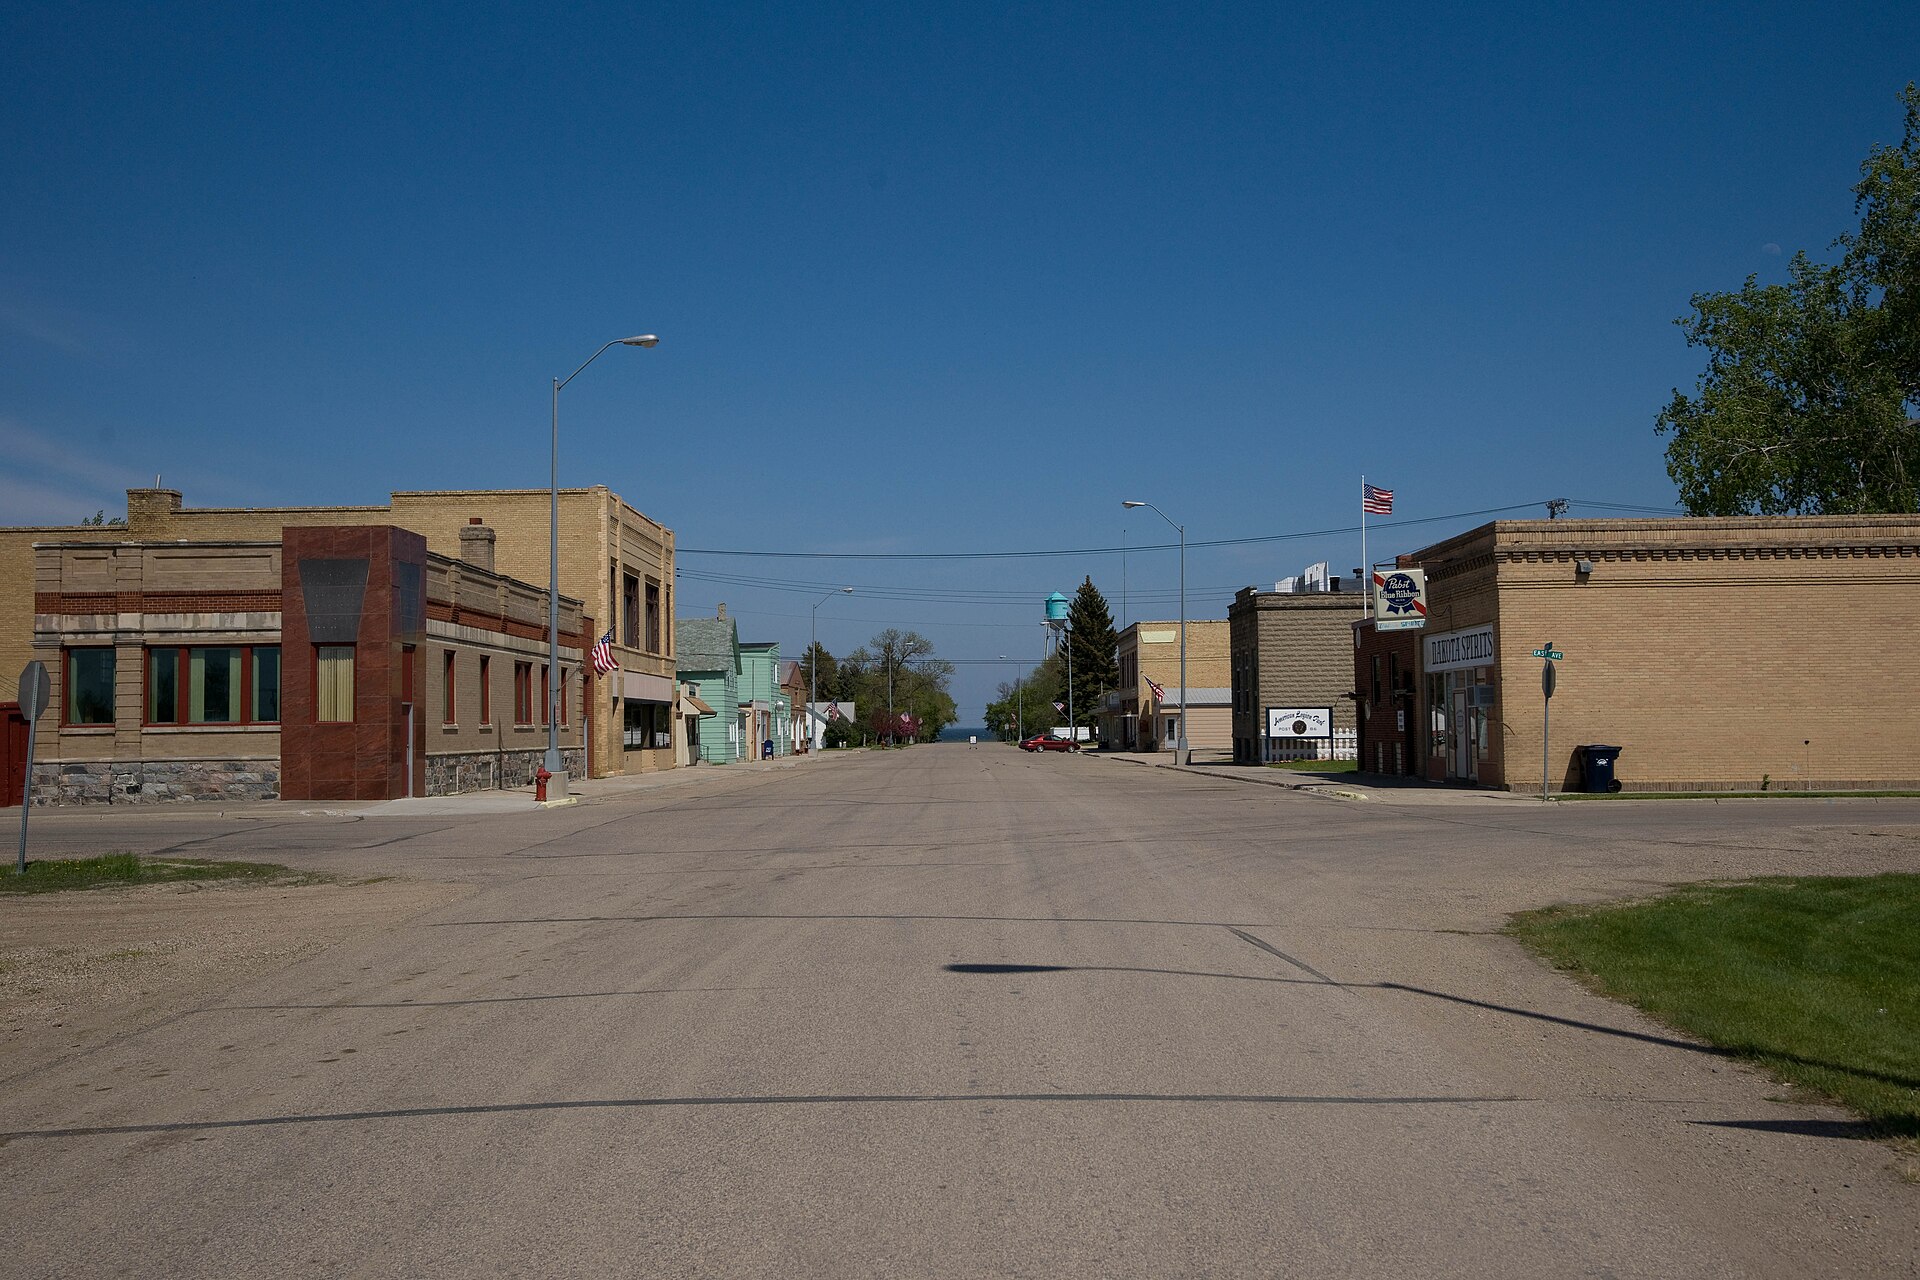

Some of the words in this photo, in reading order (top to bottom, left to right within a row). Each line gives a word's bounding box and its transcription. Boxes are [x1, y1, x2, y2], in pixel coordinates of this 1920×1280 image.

[1388, 577, 1410, 589] Pabst
[1380, 590, 1395, 599] Blue
[1396, 589, 1419, 599] Ribbon
[1431, 637, 1460, 665] DAKOTA
[1461, 631, 1493, 661] SPIRITS
[1274, 712, 1295, 726] American
[1295, 710, 1313, 720] Legion
